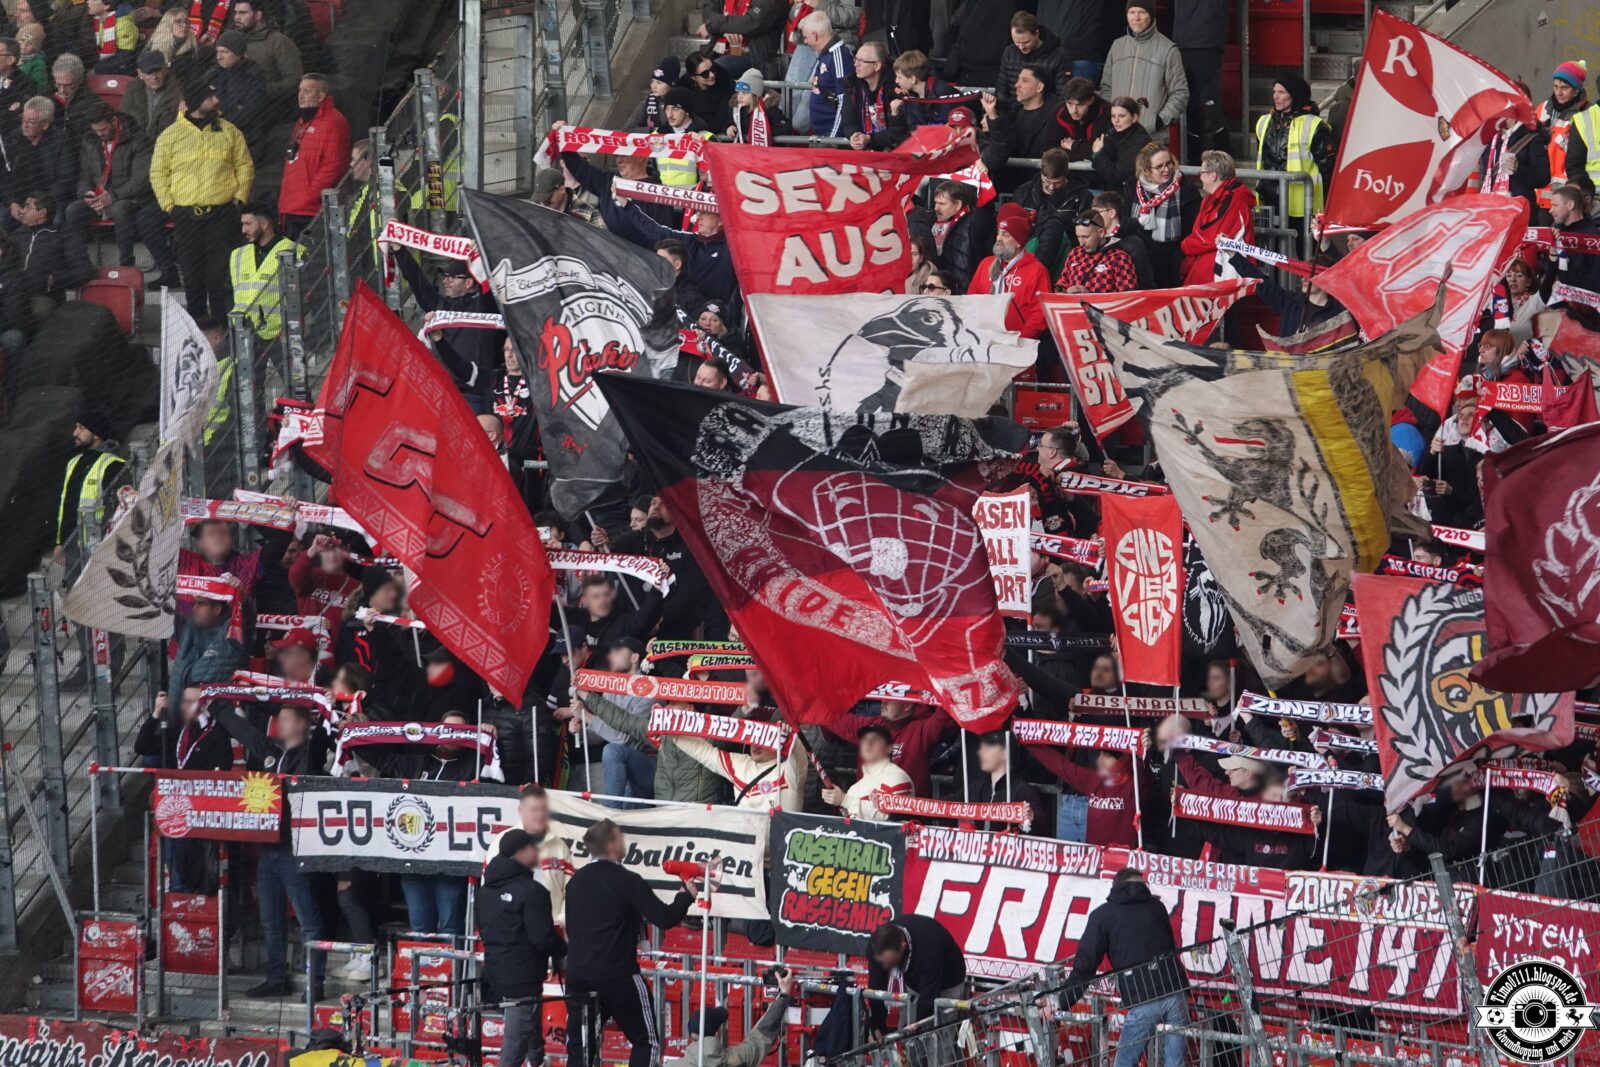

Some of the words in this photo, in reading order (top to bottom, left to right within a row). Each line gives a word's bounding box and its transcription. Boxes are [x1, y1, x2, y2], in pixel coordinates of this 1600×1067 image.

[1382, 36, 1418, 77] R
[563, 132, 627, 148] ROTEN
[1353, 168, 1405, 201] Holy
[386, 223, 429, 248] ROTEN
[432, 237, 482, 262] BULLEN
[776, 214, 904, 287] AUS
[1496, 383, 1521, 402] RB
[976, 500, 1027, 530] ASEN
[986, 537, 1019, 566] ALL
[177, 577, 210, 591] WEINE
[1387, 558, 1406, 573] RB
[1406, 562, 1460, 584] LEIPZIG
[992, 574, 1027, 604] ORT
[576, 672, 627, 690] YOUTH
[657, 681, 746, 701] GENERATION
[1249, 697, 1319, 718] ZONE
[706, 714, 739, 739] RED
[1073, 725, 1100, 747] RED
[1100, 728, 1141, 752] PRIDE
[1184, 735, 1217, 751] ONE
[1296, 770, 1359, 786] ZONE
[949, 803, 976, 819] RED
[980, 805, 1023, 821] PRIDE
[1179, 792, 1210, 817] YOUTH
[1211, 797, 1238, 821] WITH
[1237, 801, 1257, 823] BAD
[786, 831, 891, 875] RASENBALL
[918, 829, 951, 859] STAY
[953, 832, 991, 865] RUDE
[990, 834, 1024, 869] STAY
[1022, 840, 1060, 874] REBEL
[1126, 850, 1260, 885] AUSGESPERRTE
[806, 865, 872, 902] GEGEN
[1147, 872, 1176, 888] GEBT
[1180, 877, 1211, 892] NICHT
[1216, 881, 1236, 894] AUF
[1288, 876, 1354, 914] ZONE
[1492, 912, 1591, 959] SYSTEMA
[1348, 920, 1462, 1001] 147
